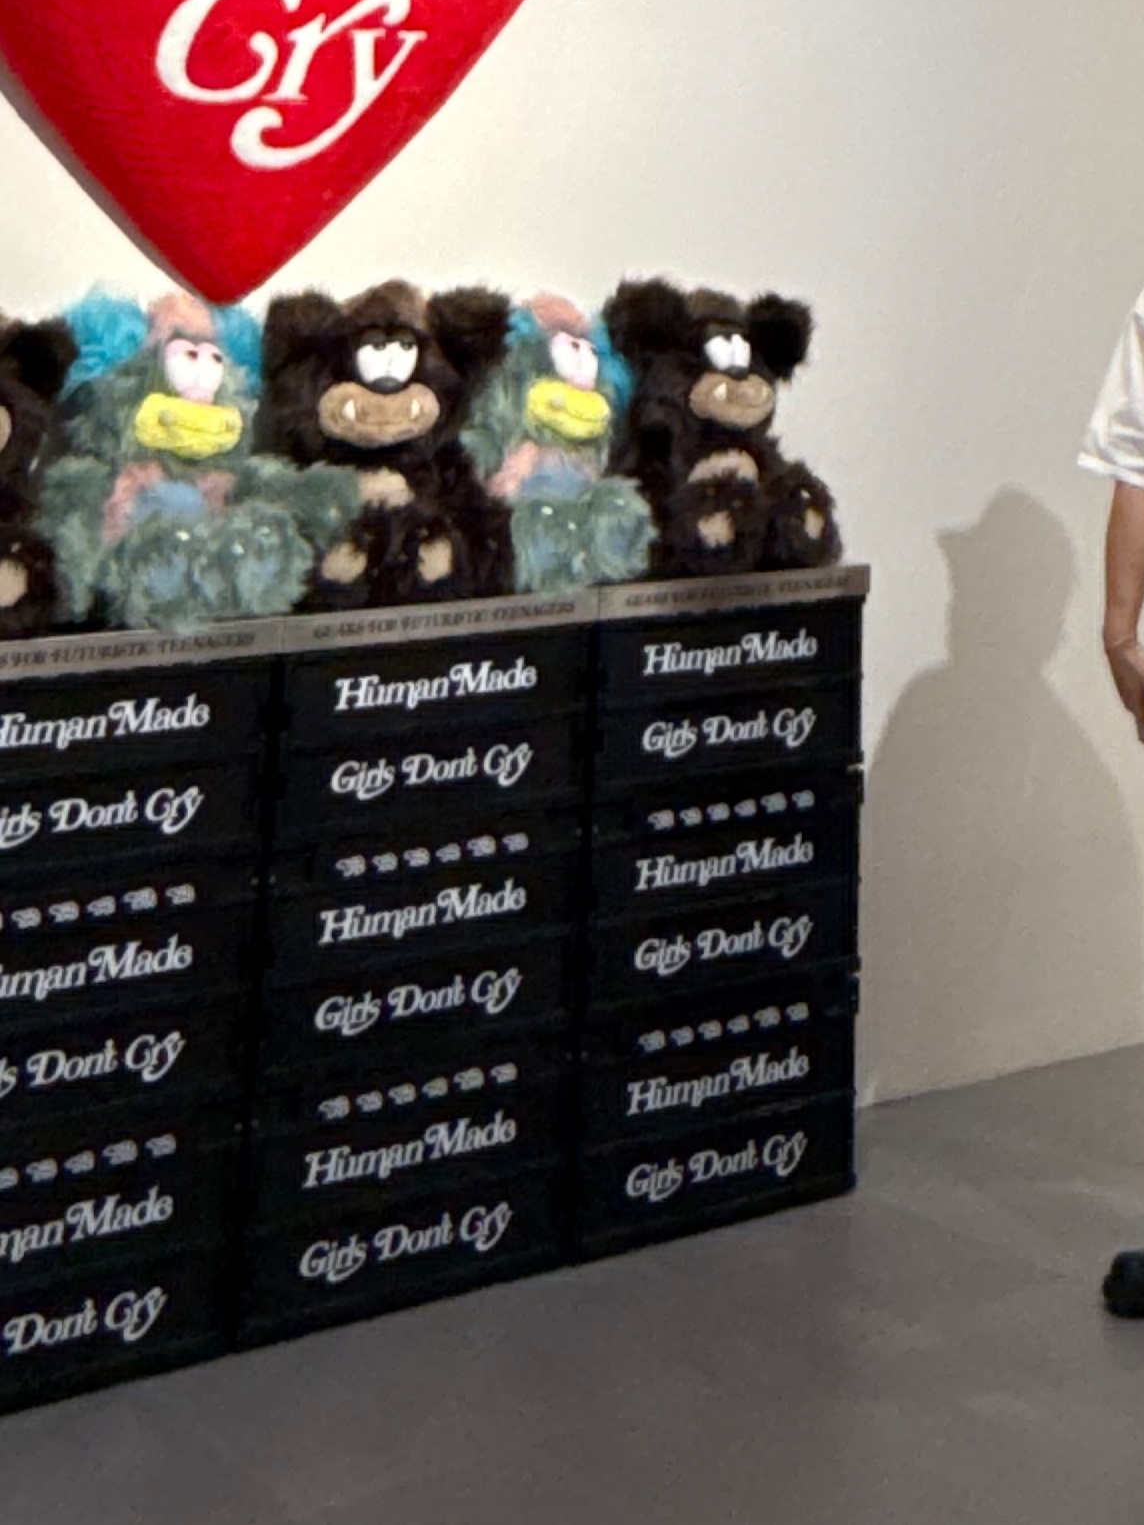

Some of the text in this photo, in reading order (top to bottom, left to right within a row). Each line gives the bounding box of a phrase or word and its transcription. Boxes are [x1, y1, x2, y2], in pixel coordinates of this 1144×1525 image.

[643, 627, 818, 674] Human Made
[334, 656, 538, 711] Human Made
[108, 692, 211, 736] Made
[642, 719, 698, 758] Girls
[773, 707, 817, 748] Cry
[330, 758, 396, 801] Girls
[483, 742, 534, 787] Cry
[145, 785, 205, 834] Cry
[634, 832, 815, 891] Human Made
[317, 876, 527, 947] Human Made
[88, 934, 193, 983] Made
[634, 934, 692, 976] Girls
[768, 915, 814, 958] Cry
[314, 990, 382, 1037] Girls
[471, 967, 523, 1014] Cry
[125, 1030, 187, 1083] Cry
[626, 1046, 810, 1117] Human Made
[302, 1110, 517, 1189] Human Made
[625, 1158, 684, 1203] Girls
[763, 1131, 808, 1177] Cry
[65, 1185, 174, 1242] Made
[300, 1233, 368, 1284] Girls
[460, 1201, 514, 1252] Cry
[104, 1285, 169, 1342] Cry
